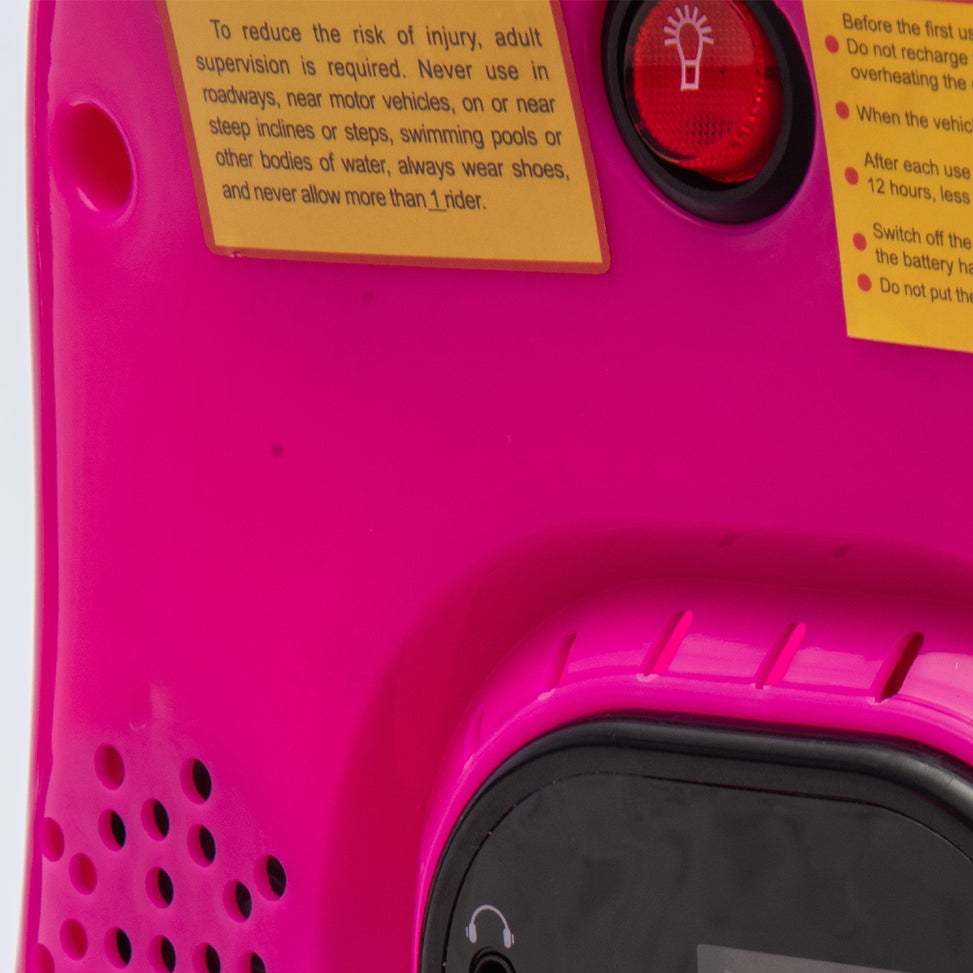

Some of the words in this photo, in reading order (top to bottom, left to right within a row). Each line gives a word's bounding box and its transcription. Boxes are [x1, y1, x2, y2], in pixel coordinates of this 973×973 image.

[209, 19, 231, 40] To
[243, 22, 301, 42] reduce
[312, 23, 341, 44] the
[353, 24, 386, 44] risk
[397, 25, 414, 45] of
[427, 27, 482, 49] injury,
[495, 27, 542, 48] adult
[843, 13, 892, 33] Before
[896, 19, 920, 36] the
[925, 21, 953, 39] first
[846, 39, 868, 55] Do
[873, 42, 897, 58] not
[901, 44, 967, 68] recharge
[196, 54, 289, 77] supervision
[301, 55, 316, 76] is
[328, 58, 406, 81] required.
[418, 59, 471, 80] Never
[486, 64, 518, 80] use
[532, 60, 549, 81] in
[851, 65, 938, 91] overheating
[943, 73, 966, 90] the
[202, 85, 280, 111] roadways,
[286, 91, 322, 108] near
[330, 93, 375, 110] motor
[383, 92, 455, 114] vehicles,
[462, 97, 484, 112] on
[491, 98, 508, 113] or
[516, 98, 555, 114] near
[856, 104, 900, 124] When
[905, 110, 929, 128] the
[209, 118, 251, 141] steep
[257, 118, 314, 140] inclines
[321, 124, 338, 140] or
[345, 123, 393, 145] steps,
[400, 126, 484, 149] swimming
[491, 127, 538, 150] pools
[545, 130, 562, 148] or
[216, 149, 253, 169] other
[261, 150, 312, 171] bodies
[319, 152, 335, 172] of
[341, 155, 391, 177] water,
[398, 156, 455, 180] always
[461, 161, 503, 178] wear
[512, 159, 570, 181] shoes,
[864, 152, 898, 170] After
[904, 159, 939, 176] each
[943, 165, 971, 180] use
[222, 181, 250, 200] and
[254, 184, 297, 202] never
[301, 184, 341, 204] allow
[345, 189, 386, 206] more
[389, 188, 426, 208] than
[444, 189, 486, 211] rider.
[867, 177, 885, 195] 12
[890, 181, 936, 202] hours,
[940, 186, 970, 204] less
[873, 222, 921, 244] Switch
[926, 230, 944, 246] off
[949, 232, 972, 249] the
[875, 248, 898, 265] the
[903, 252, 953, 275] battery
[880, 277, 900, 294] Do
[904, 282, 926, 298] not
[930, 285, 951, 302] put
